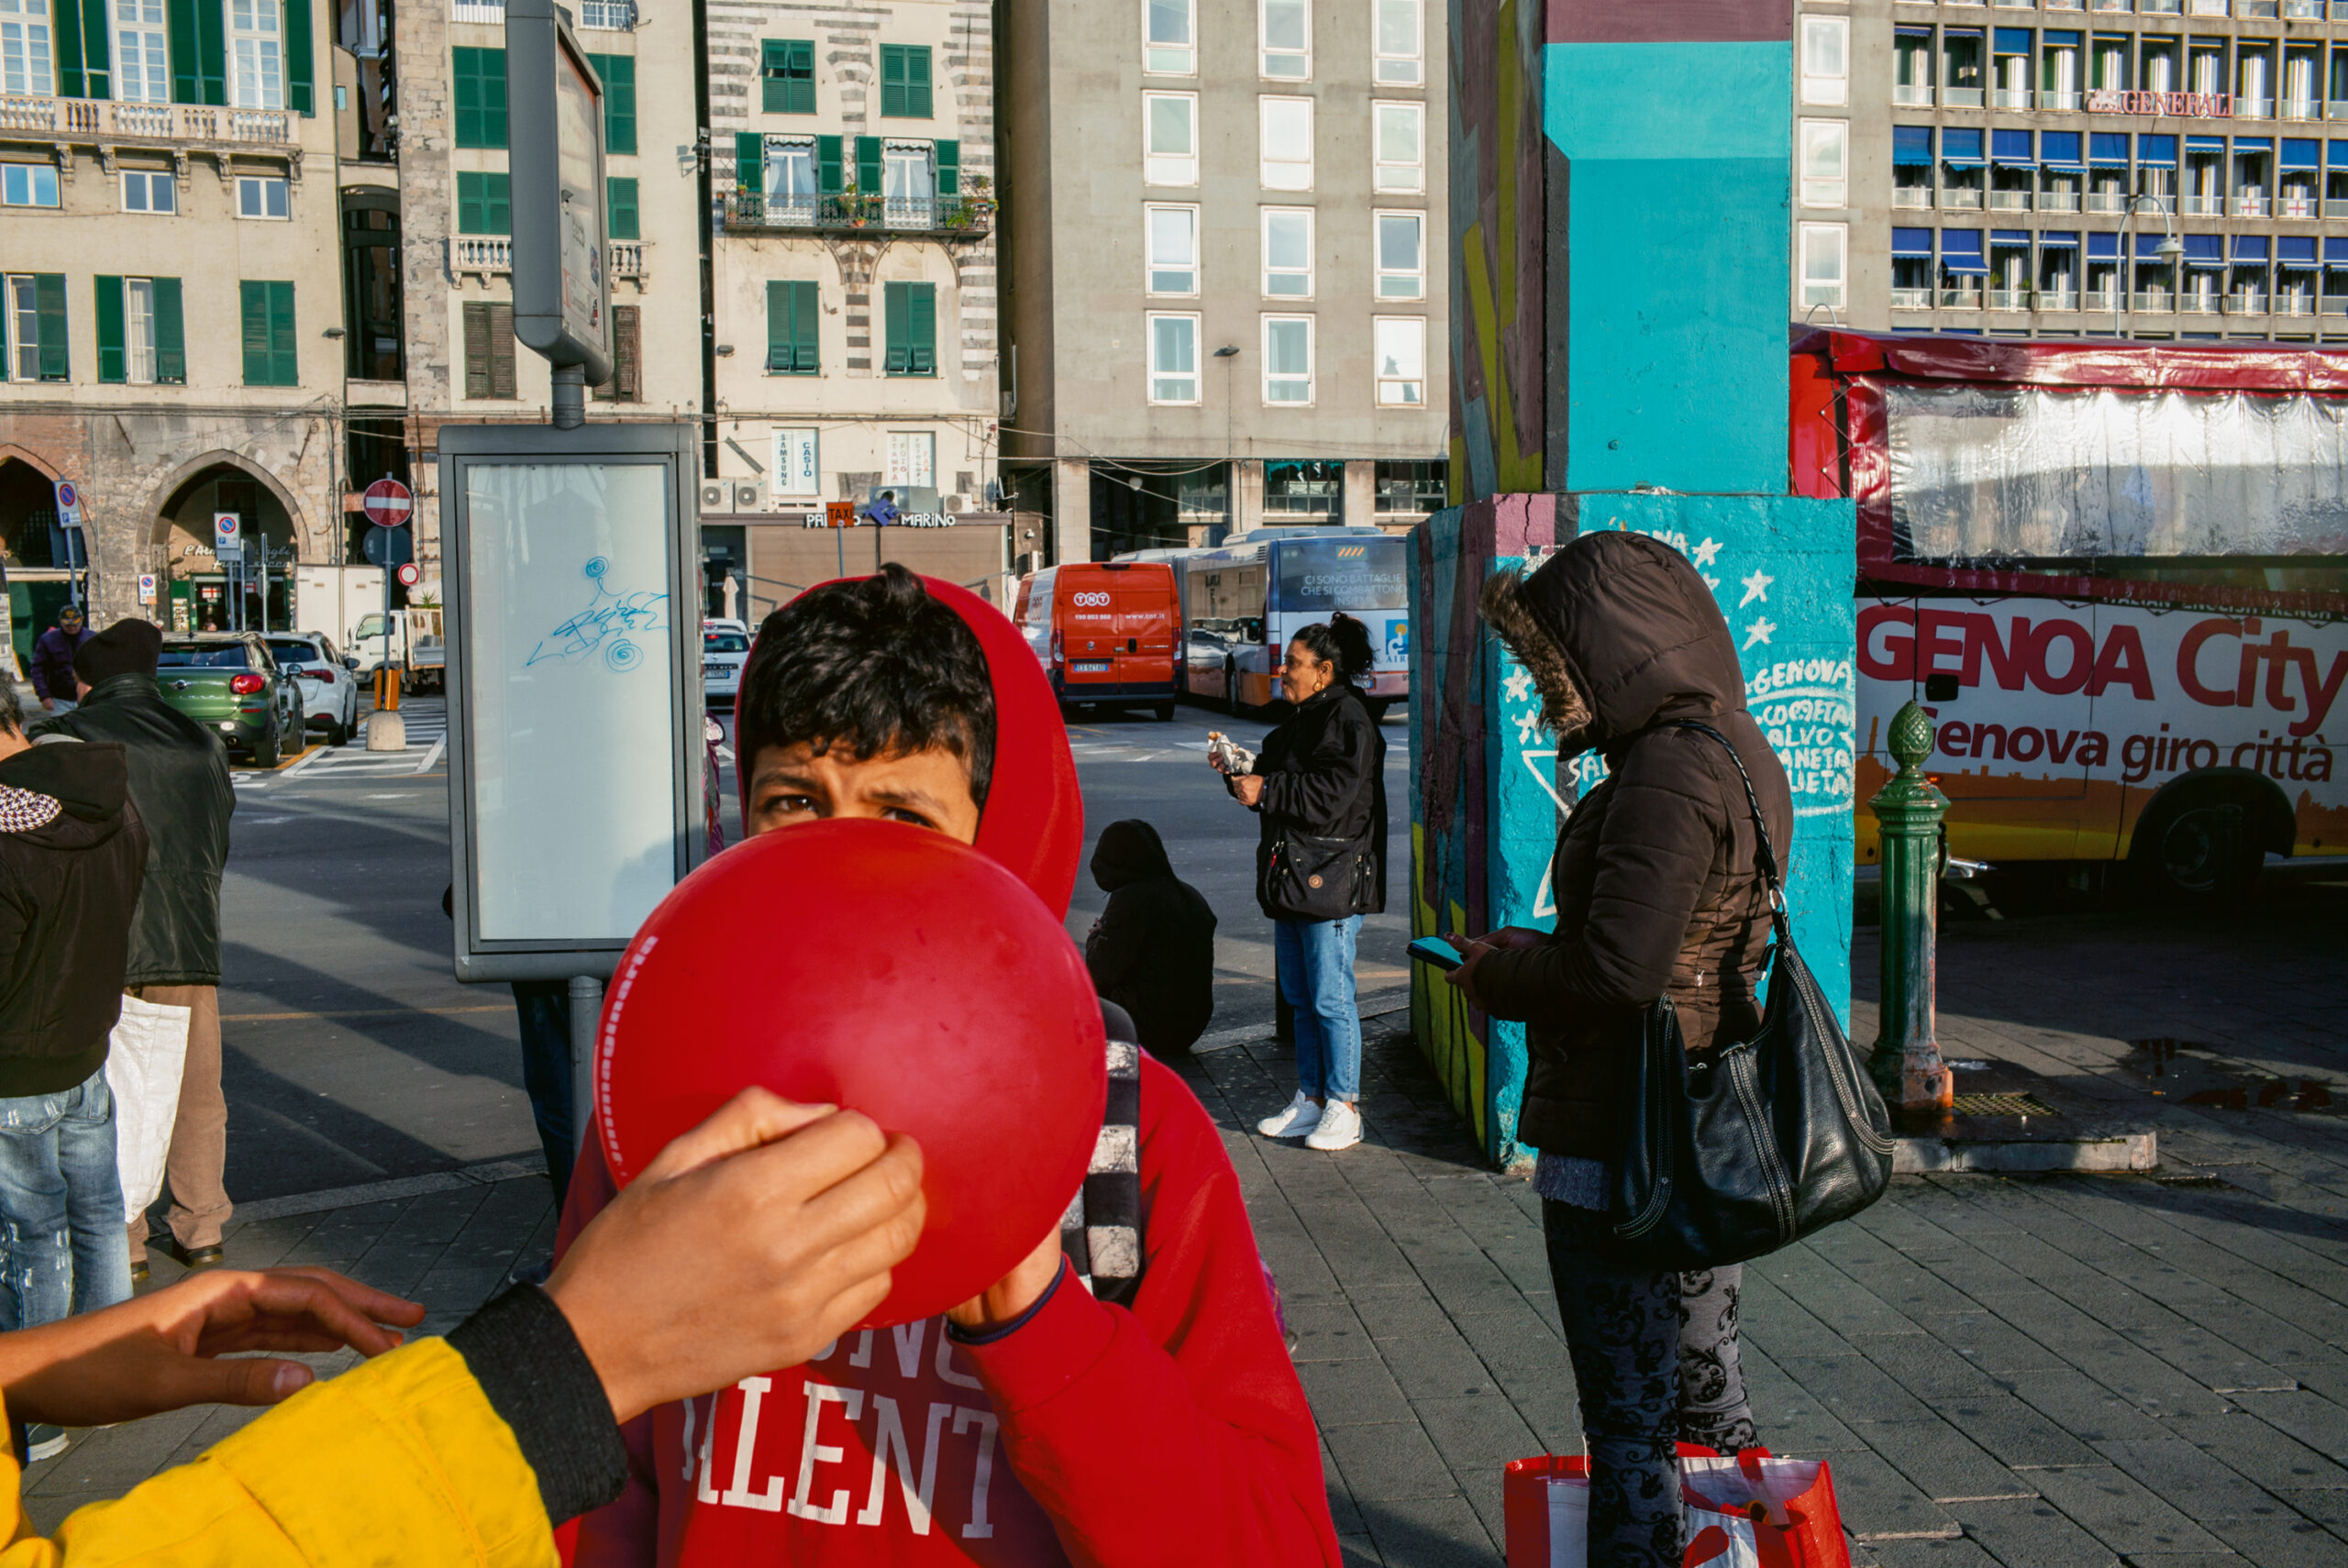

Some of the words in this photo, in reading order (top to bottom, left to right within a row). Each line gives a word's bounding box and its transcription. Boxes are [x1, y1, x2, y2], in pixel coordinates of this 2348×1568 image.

[2122, 90, 2234, 116] GENERALI
[803, 442, 812, 477] CASIO
[829, 508, 853, 520] TAXI
[1301, 586, 1322, 596] CHE
[1323, 586, 1333, 595] SI
[1304, 575, 1315, 585] CI
[1317, 574, 1348, 585] SONO
[1349, 573, 1402, 583] BATTAGLIE
[1075, 593, 1109, 605] TNT
[1754, 658, 1852, 695] GENOVA
[1855, 604, 2155, 701] GENOA
[2176, 616, 2348, 737] City
[2121, 723, 2220, 783] giro
[2231, 729, 2333, 783] città
